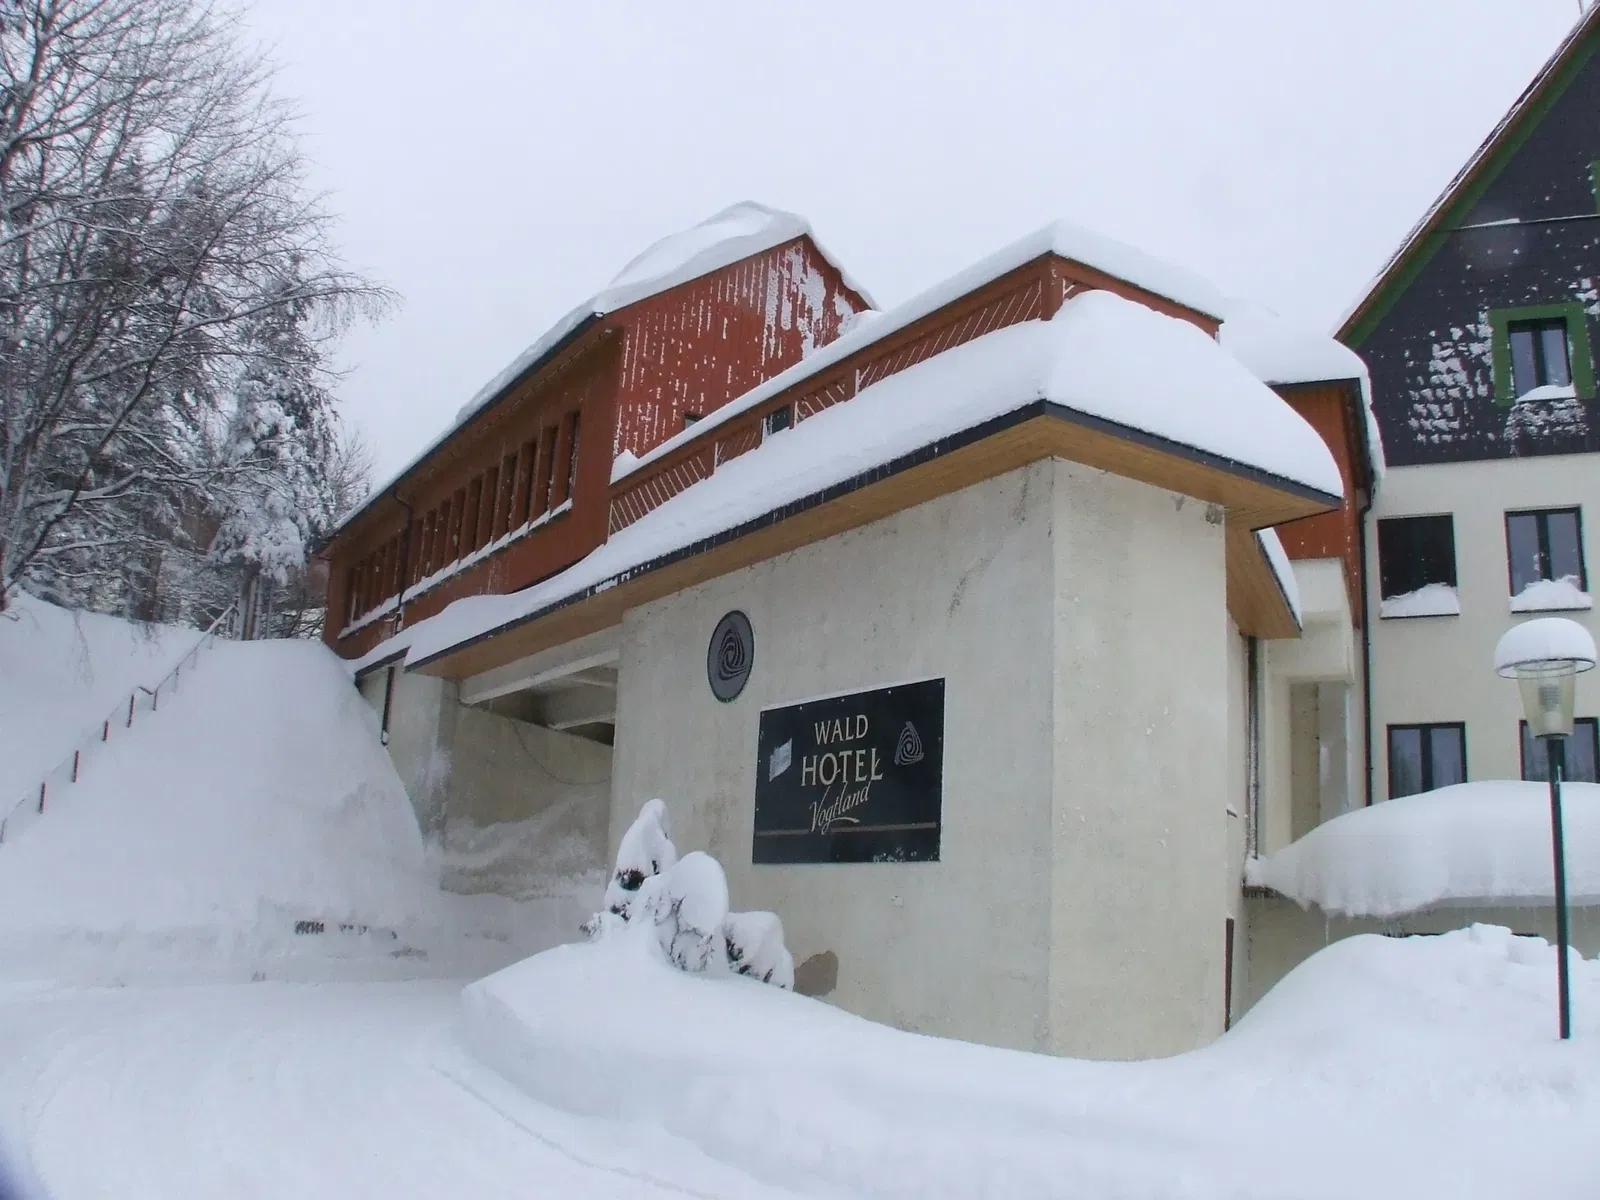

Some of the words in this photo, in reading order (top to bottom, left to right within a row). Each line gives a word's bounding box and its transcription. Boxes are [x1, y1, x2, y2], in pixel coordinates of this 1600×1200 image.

[814, 714, 869, 745] WALD
[801, 748, 884, 787] HOTEL
[809, 781, 872, 835] Vogtland
